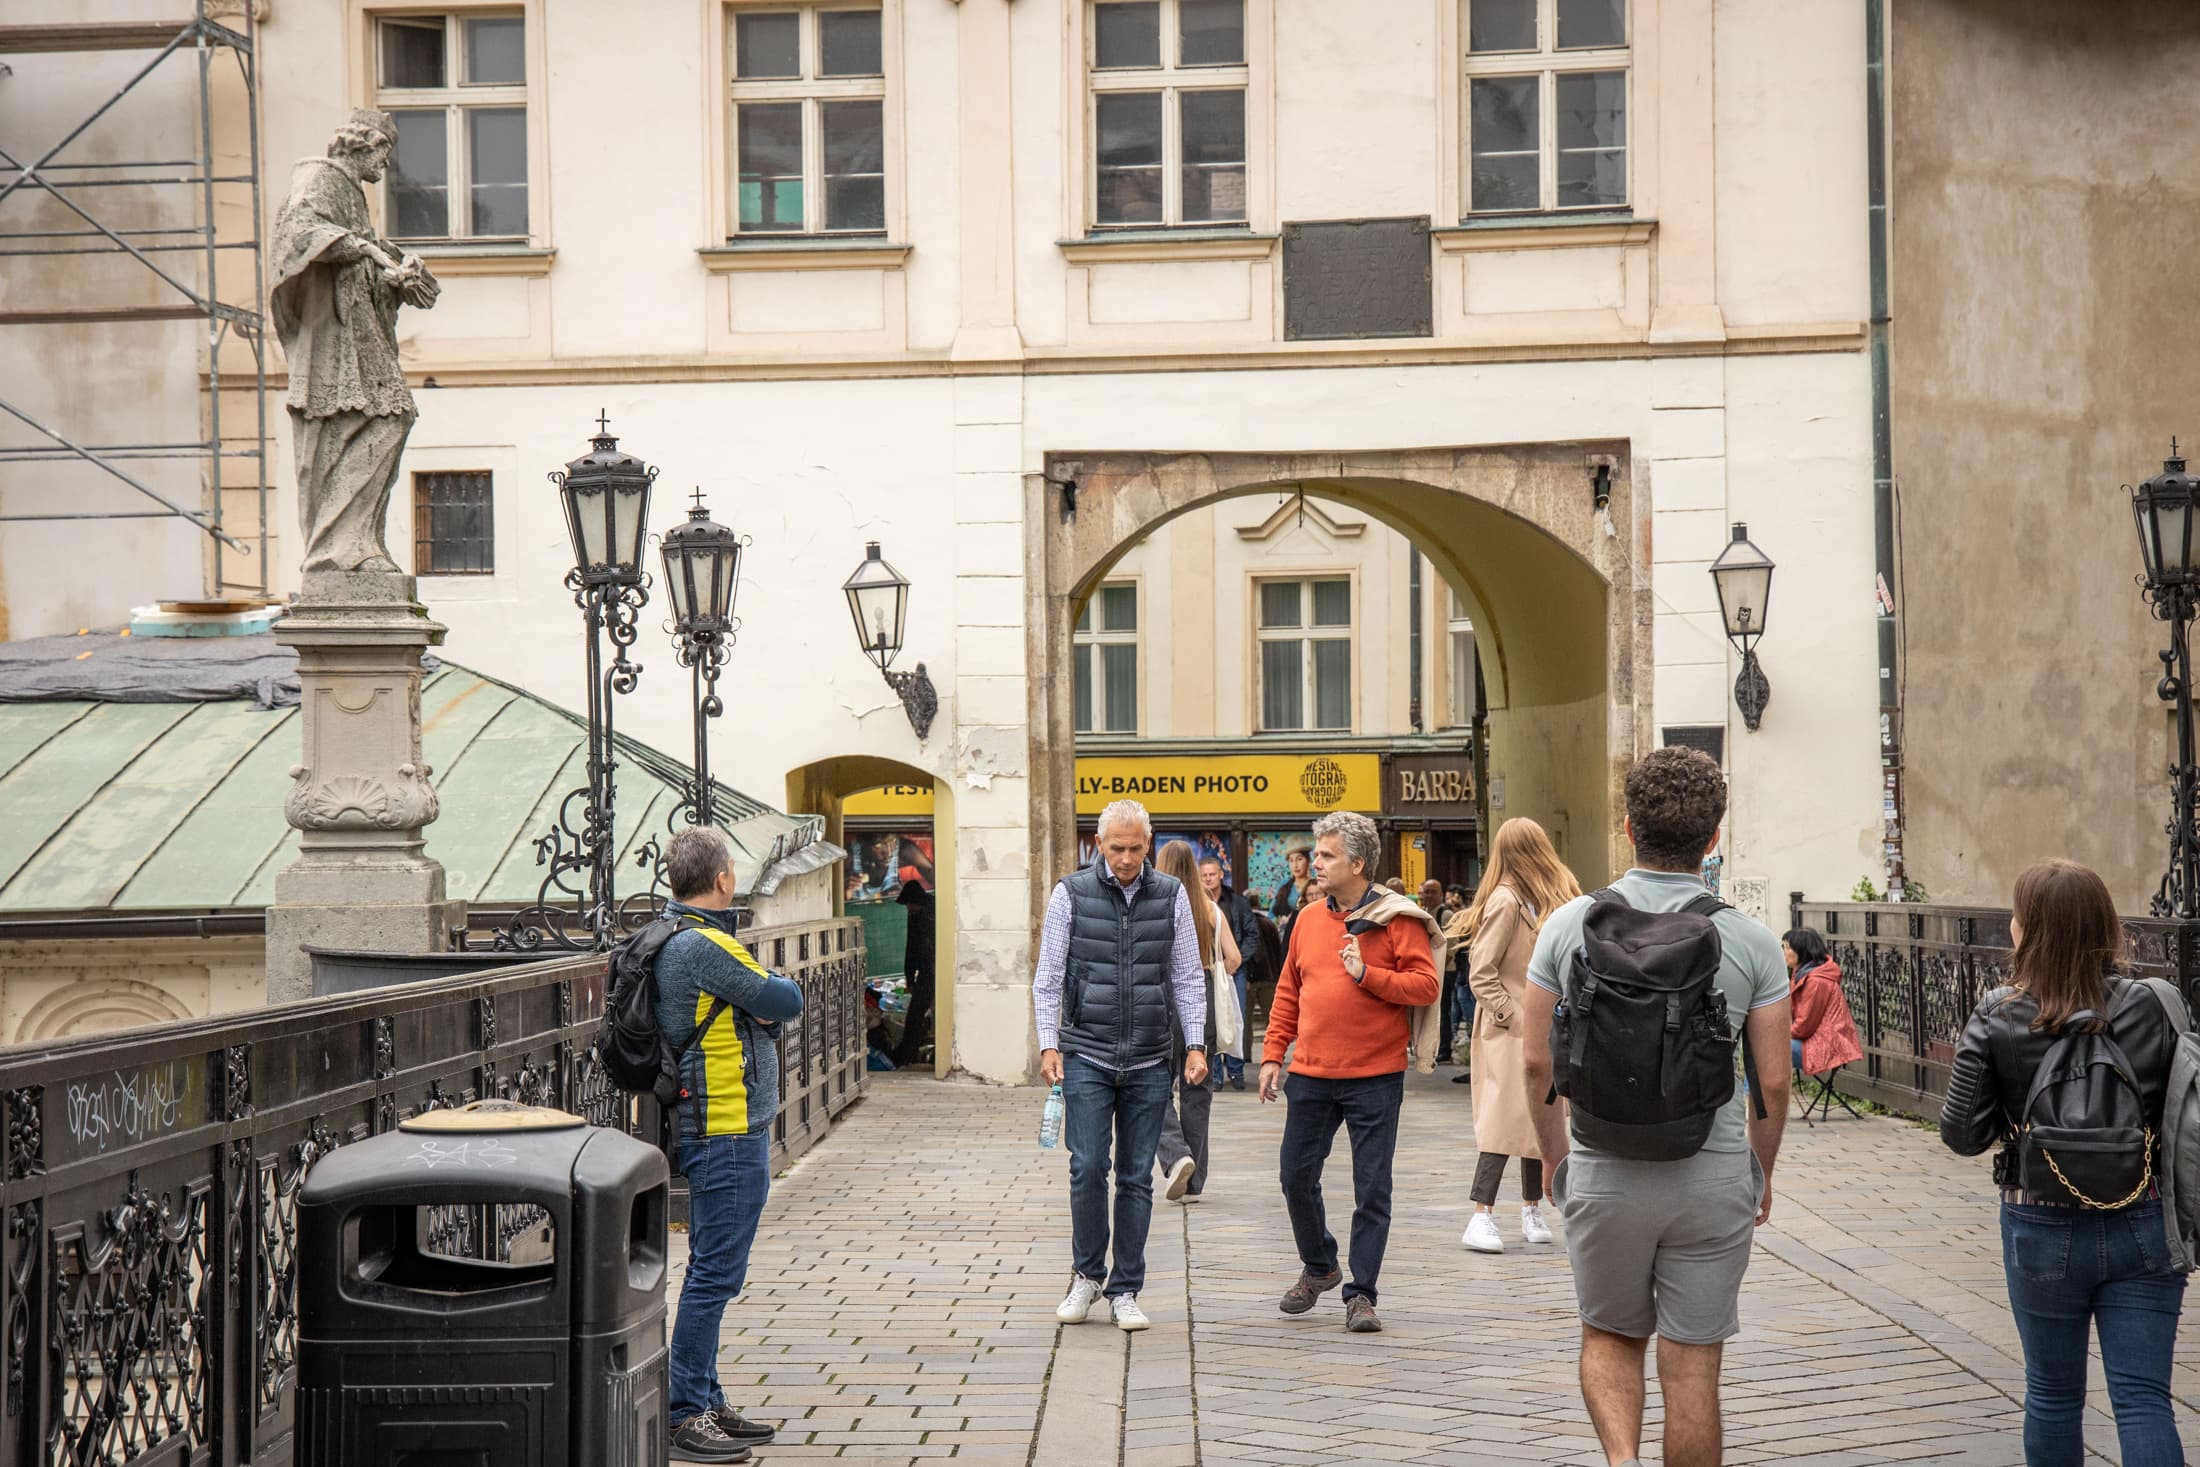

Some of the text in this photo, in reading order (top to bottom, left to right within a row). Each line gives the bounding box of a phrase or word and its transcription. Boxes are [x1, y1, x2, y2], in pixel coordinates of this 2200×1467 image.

[1075, 775, 1269, 794] LY-BADEN PHOTO
[1400, 770, 1476, 801] BARBA
